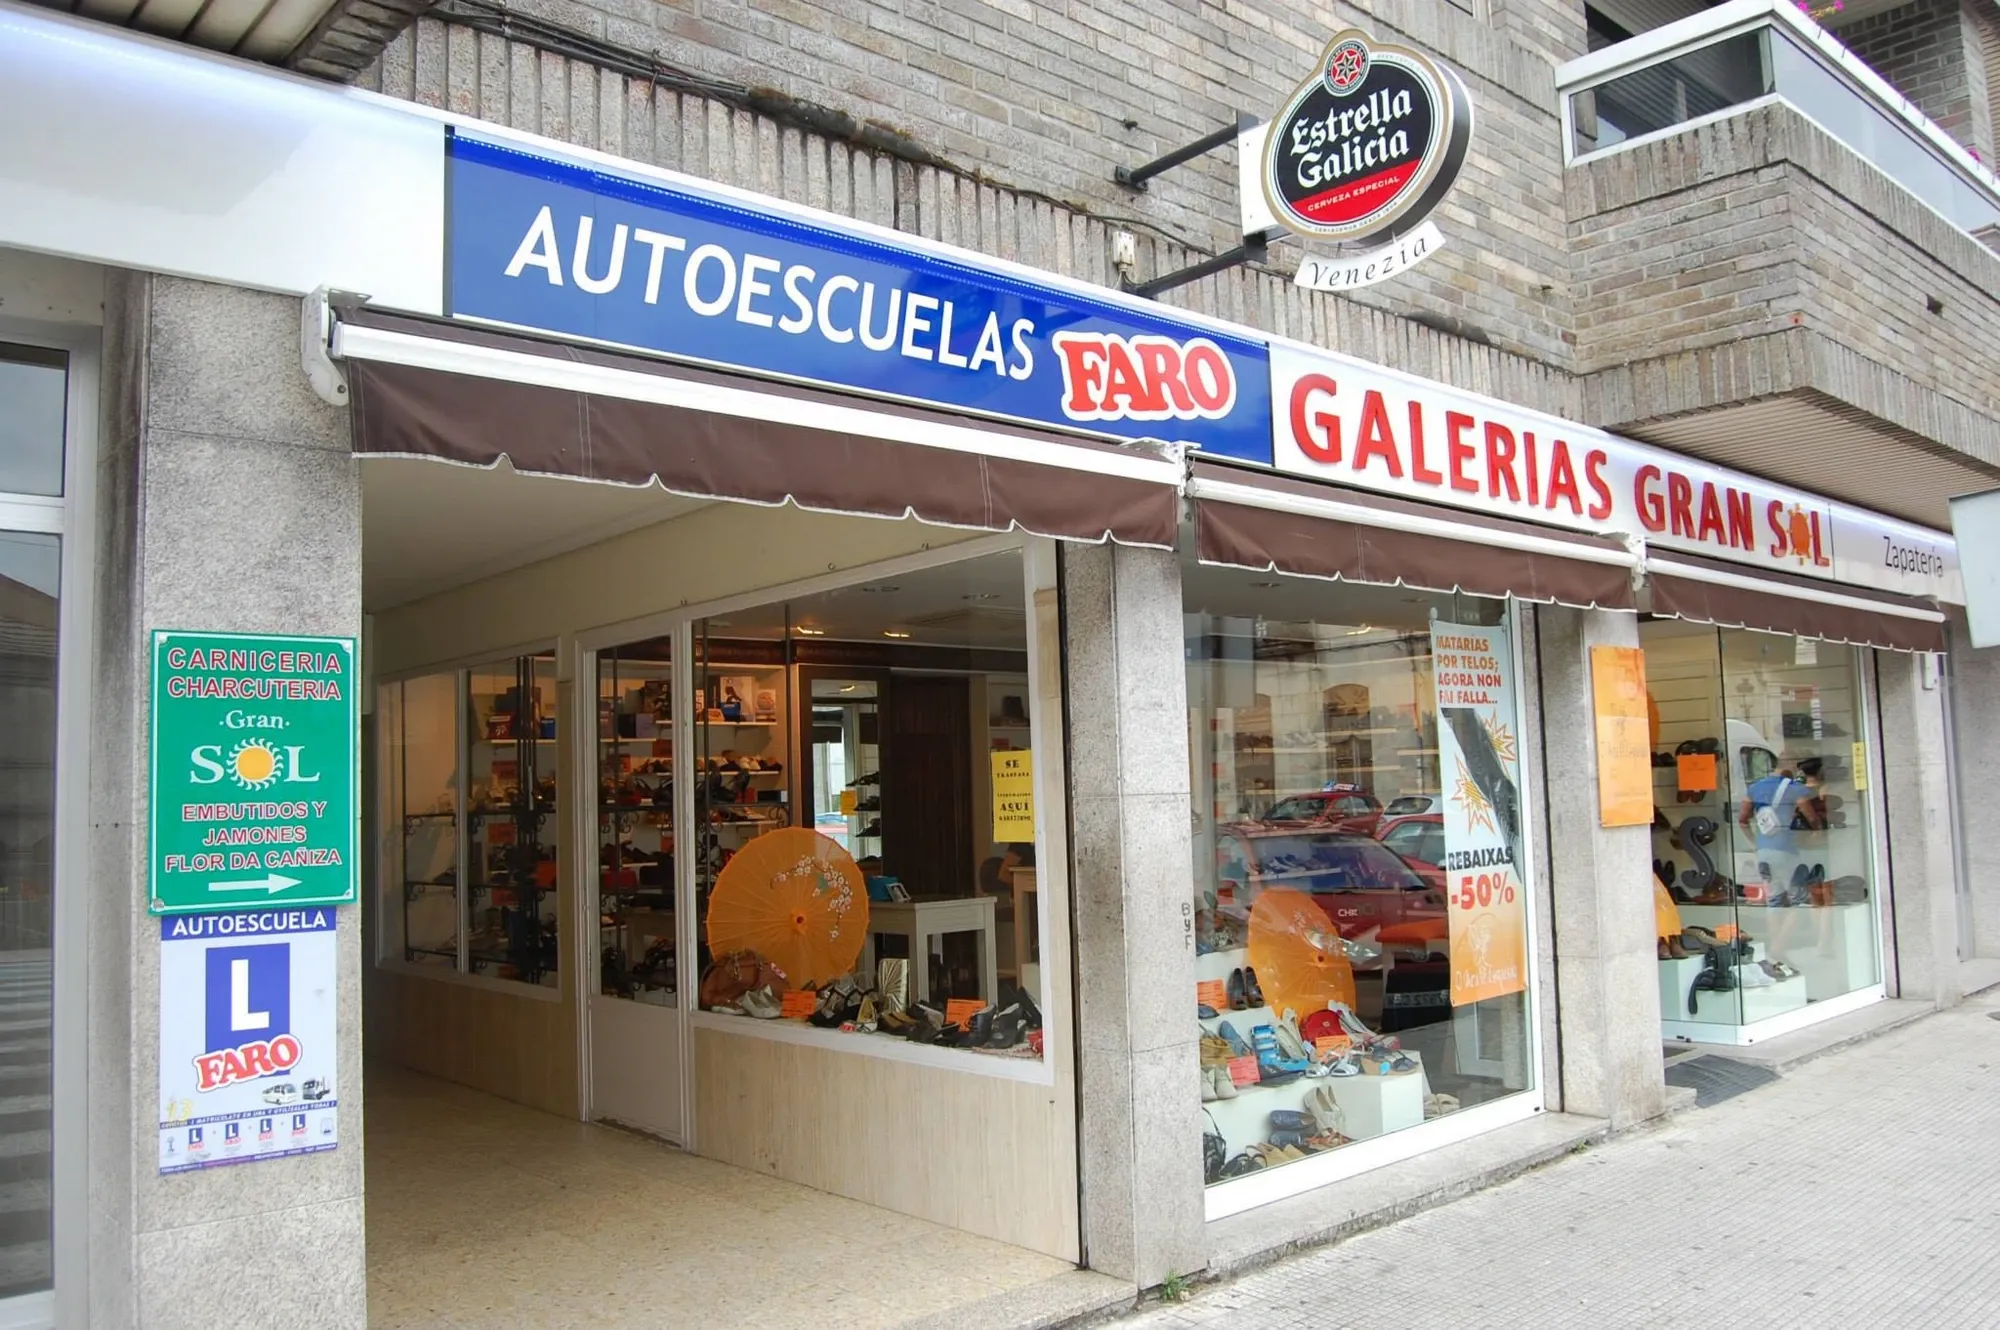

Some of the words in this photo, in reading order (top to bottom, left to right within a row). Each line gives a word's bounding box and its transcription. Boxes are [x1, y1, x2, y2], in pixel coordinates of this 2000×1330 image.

[1289, 87, 1413, 156] Estrella
[1297, 127, 1410, 189] Galicia
[1307, 192, 1351, 212] CERVEZA
[1353, 175, 1400, 198] ESPECIAL
[1308, 236, 1428, 287] Venezia
[503, 204, 1035, 380] AUTOESCUELAS
[1056, 336, 1234, 418] FARO
[1289, 373, 1612, 520] GALERIAS
[1634, 464, 1755, 552] GRAN
[1883, 535, 1944, 578] Zapatería
[168, 648, 341, 673] CARNICERIA
[1437, 654, 1457, 668] POR
[168, 676, 342, 700] CHARCUTERIA
[1438, 672, 1474, 687] AGORA
[1477, 674, 1502, 688] NON
[1439, 690, 1453, 704] FAI
[1457, 690, 1498, 705] FALLA...
[1005, 760, 1020, 768] SE
[182, 802, 307, 822] EMBUTIDOS
[313, 801, 327, 818] Y
[203, 826, 306, 847] JAMONES
[164, 853, 225, 873] FLOR
[231, 852, 260, 870] DA
[265, 847, 342, 868] CAÑIZA
[1448, 846, 1514, 871] REBAIXAS
[1451, 871, 1515, 911] -50%
[171, 910, 327, 937] AUTOESCUELA
[231, 959, 270, 1032] L
[194, 1035, 301, 1091] FARO
